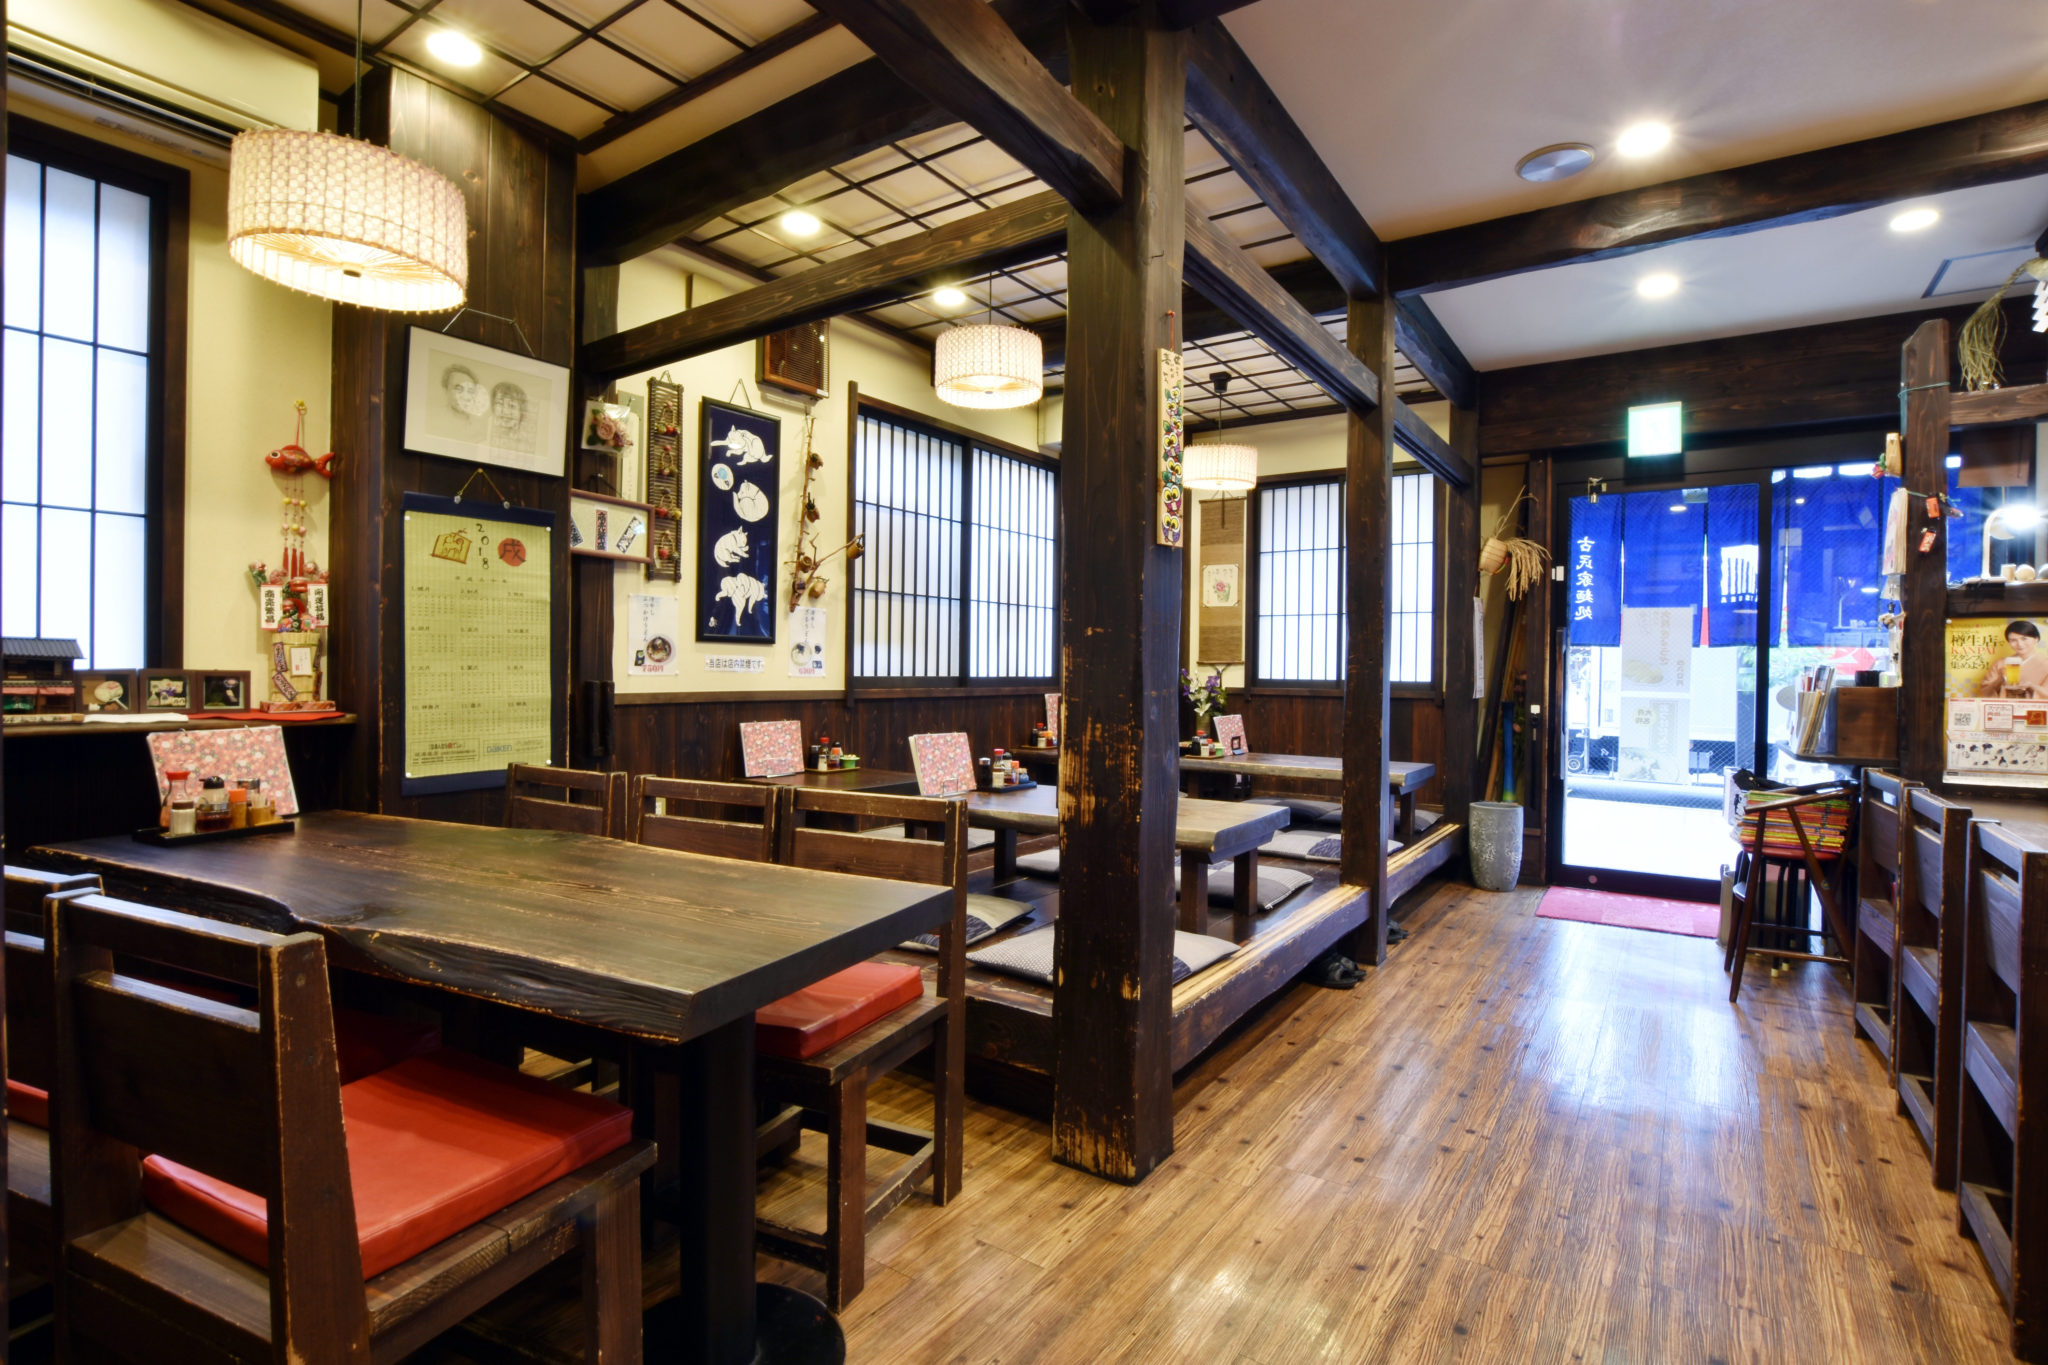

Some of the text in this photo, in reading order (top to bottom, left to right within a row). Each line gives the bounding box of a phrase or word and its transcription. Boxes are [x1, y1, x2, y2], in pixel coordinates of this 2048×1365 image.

[475, 523, 490, 569] 2018
[1951, 634, 2005, 647] 樽生店で
[1951, 647, 1996, 655] KANPAI
